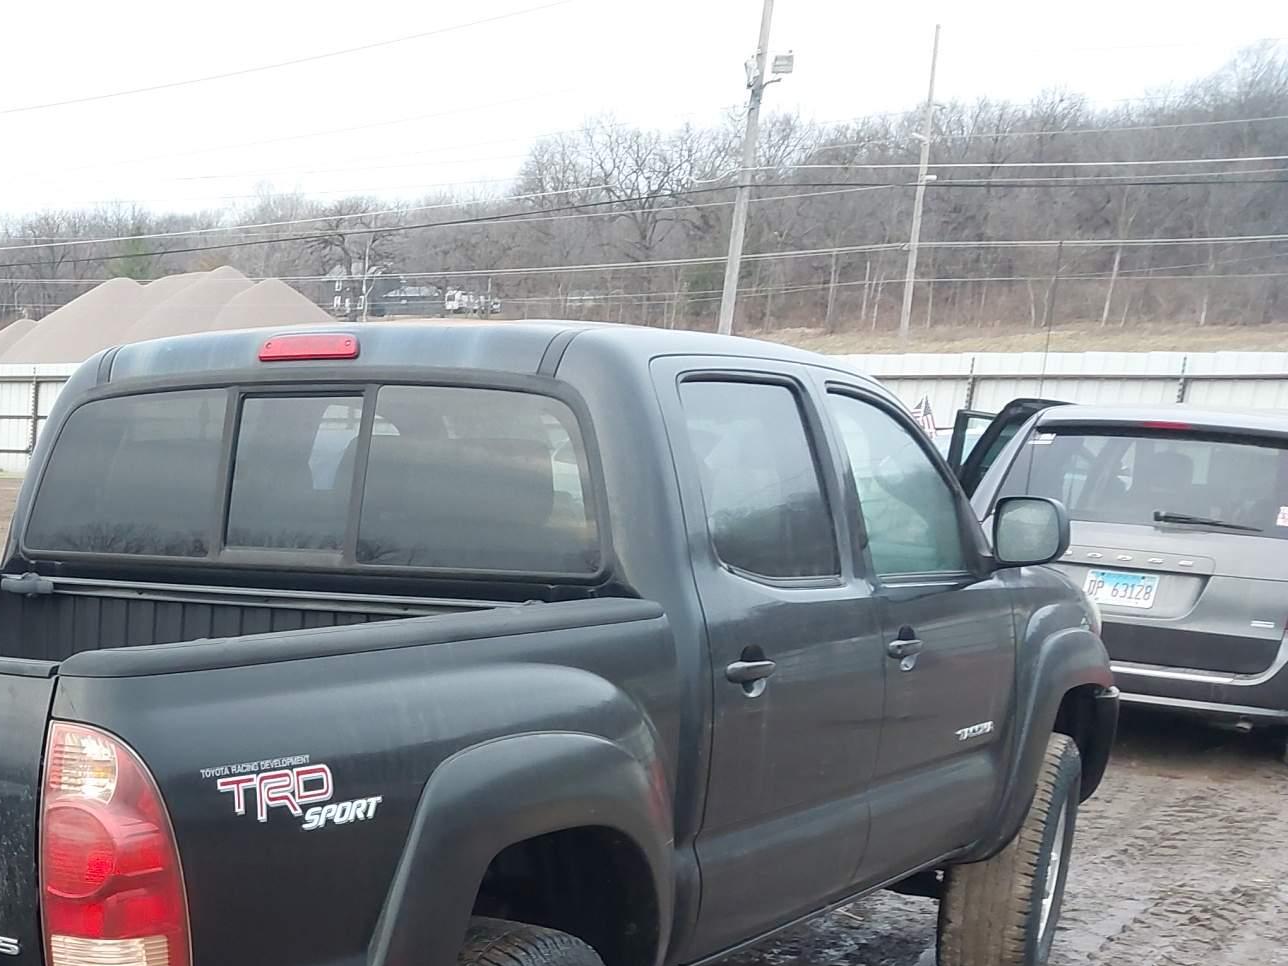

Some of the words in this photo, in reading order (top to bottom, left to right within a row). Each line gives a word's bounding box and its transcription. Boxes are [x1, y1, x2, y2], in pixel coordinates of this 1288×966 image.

[197, 767, 230, 780] TOYOTA
[230, 760, 260, 775] RACING
[260, 754, 311, 771] DEVELOPMENT
[217, 763, 334, 823] TRD
[302, 795, 384, 832] SPORT
